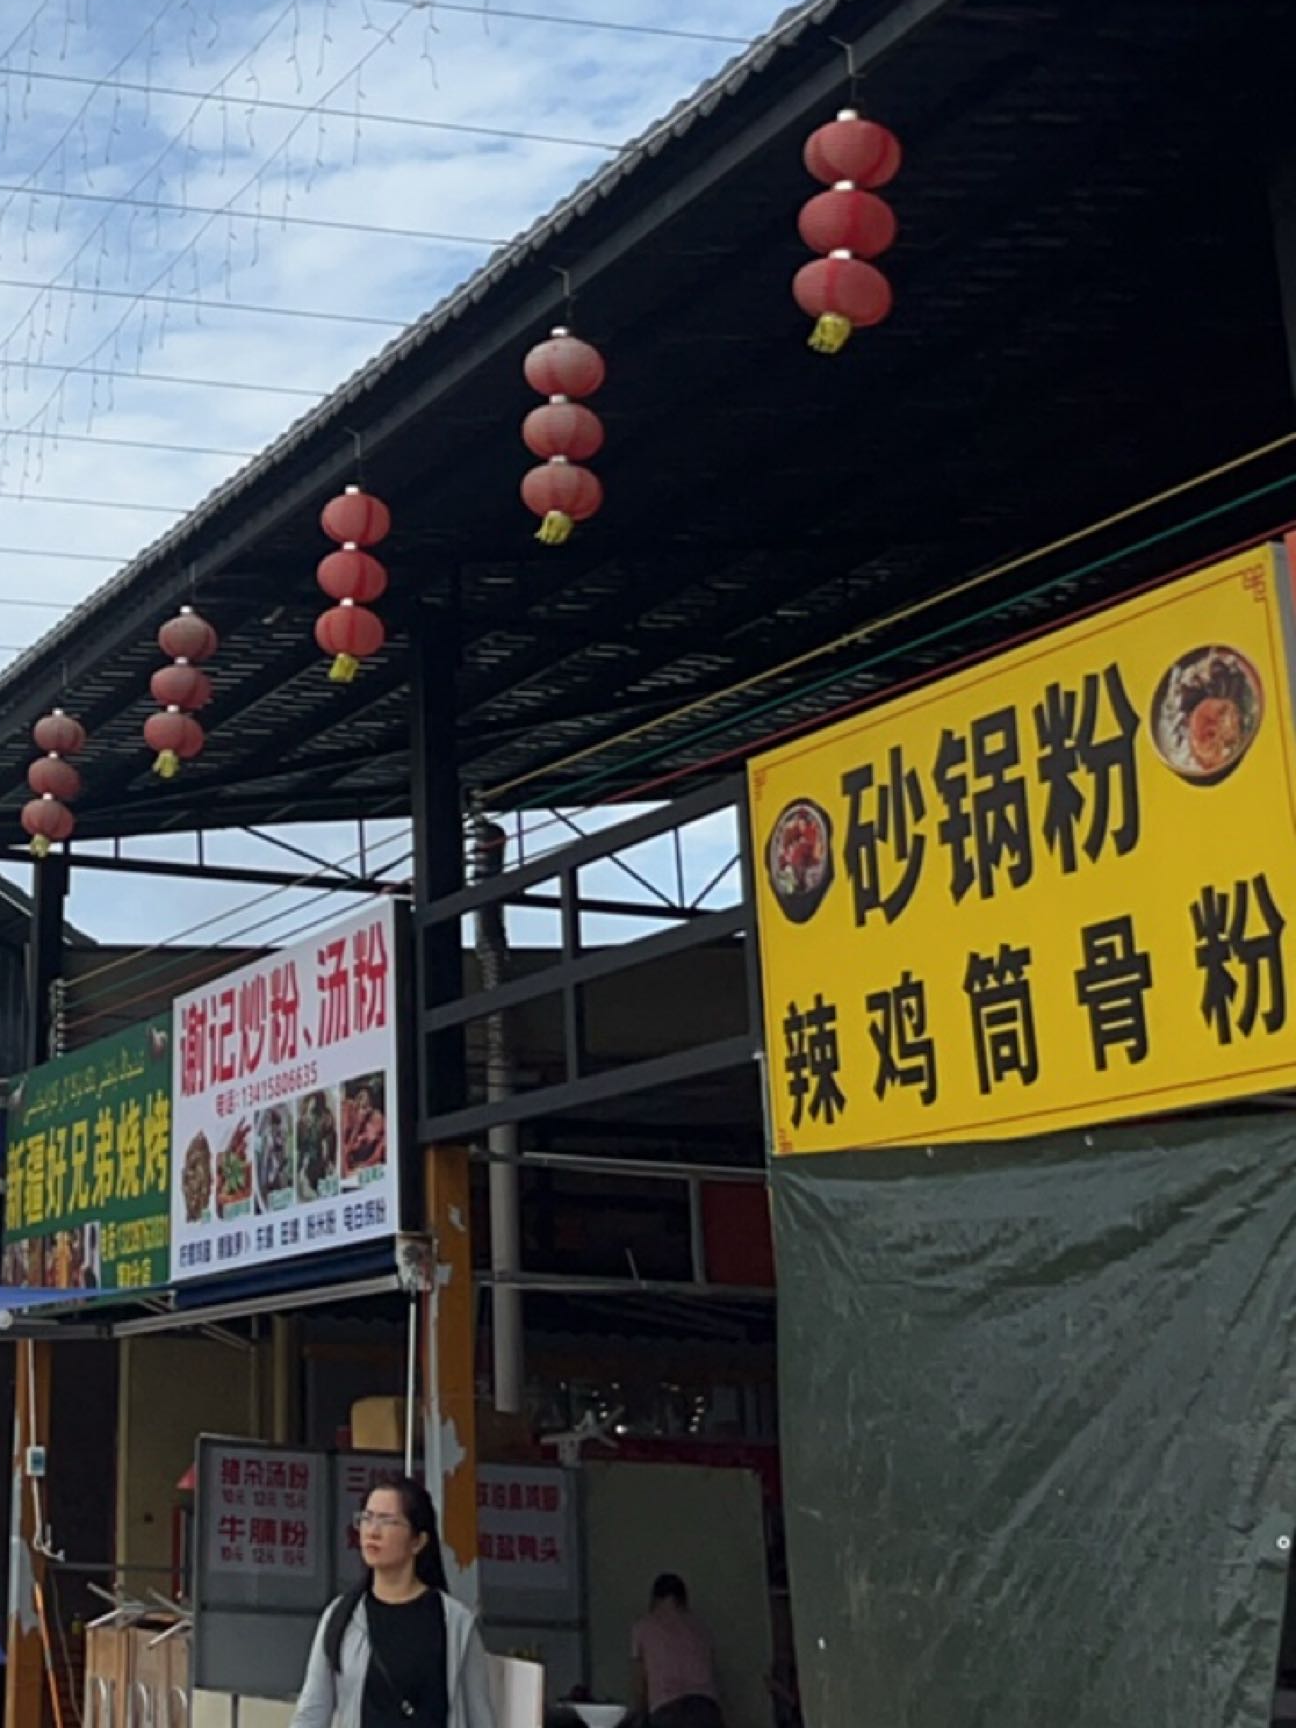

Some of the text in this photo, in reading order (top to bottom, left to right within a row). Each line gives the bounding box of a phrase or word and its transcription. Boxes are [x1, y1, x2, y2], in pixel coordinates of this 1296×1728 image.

[841, 662, 1141, 929] 砂锅粉
[180, 921, 388, 1097] 谢记炒粉、汤粉
[782, 872, 1287, 1130] 辣鸡筒骨粉
[6, 1089, 169, 1231] 新疆好兄弟烧烤
